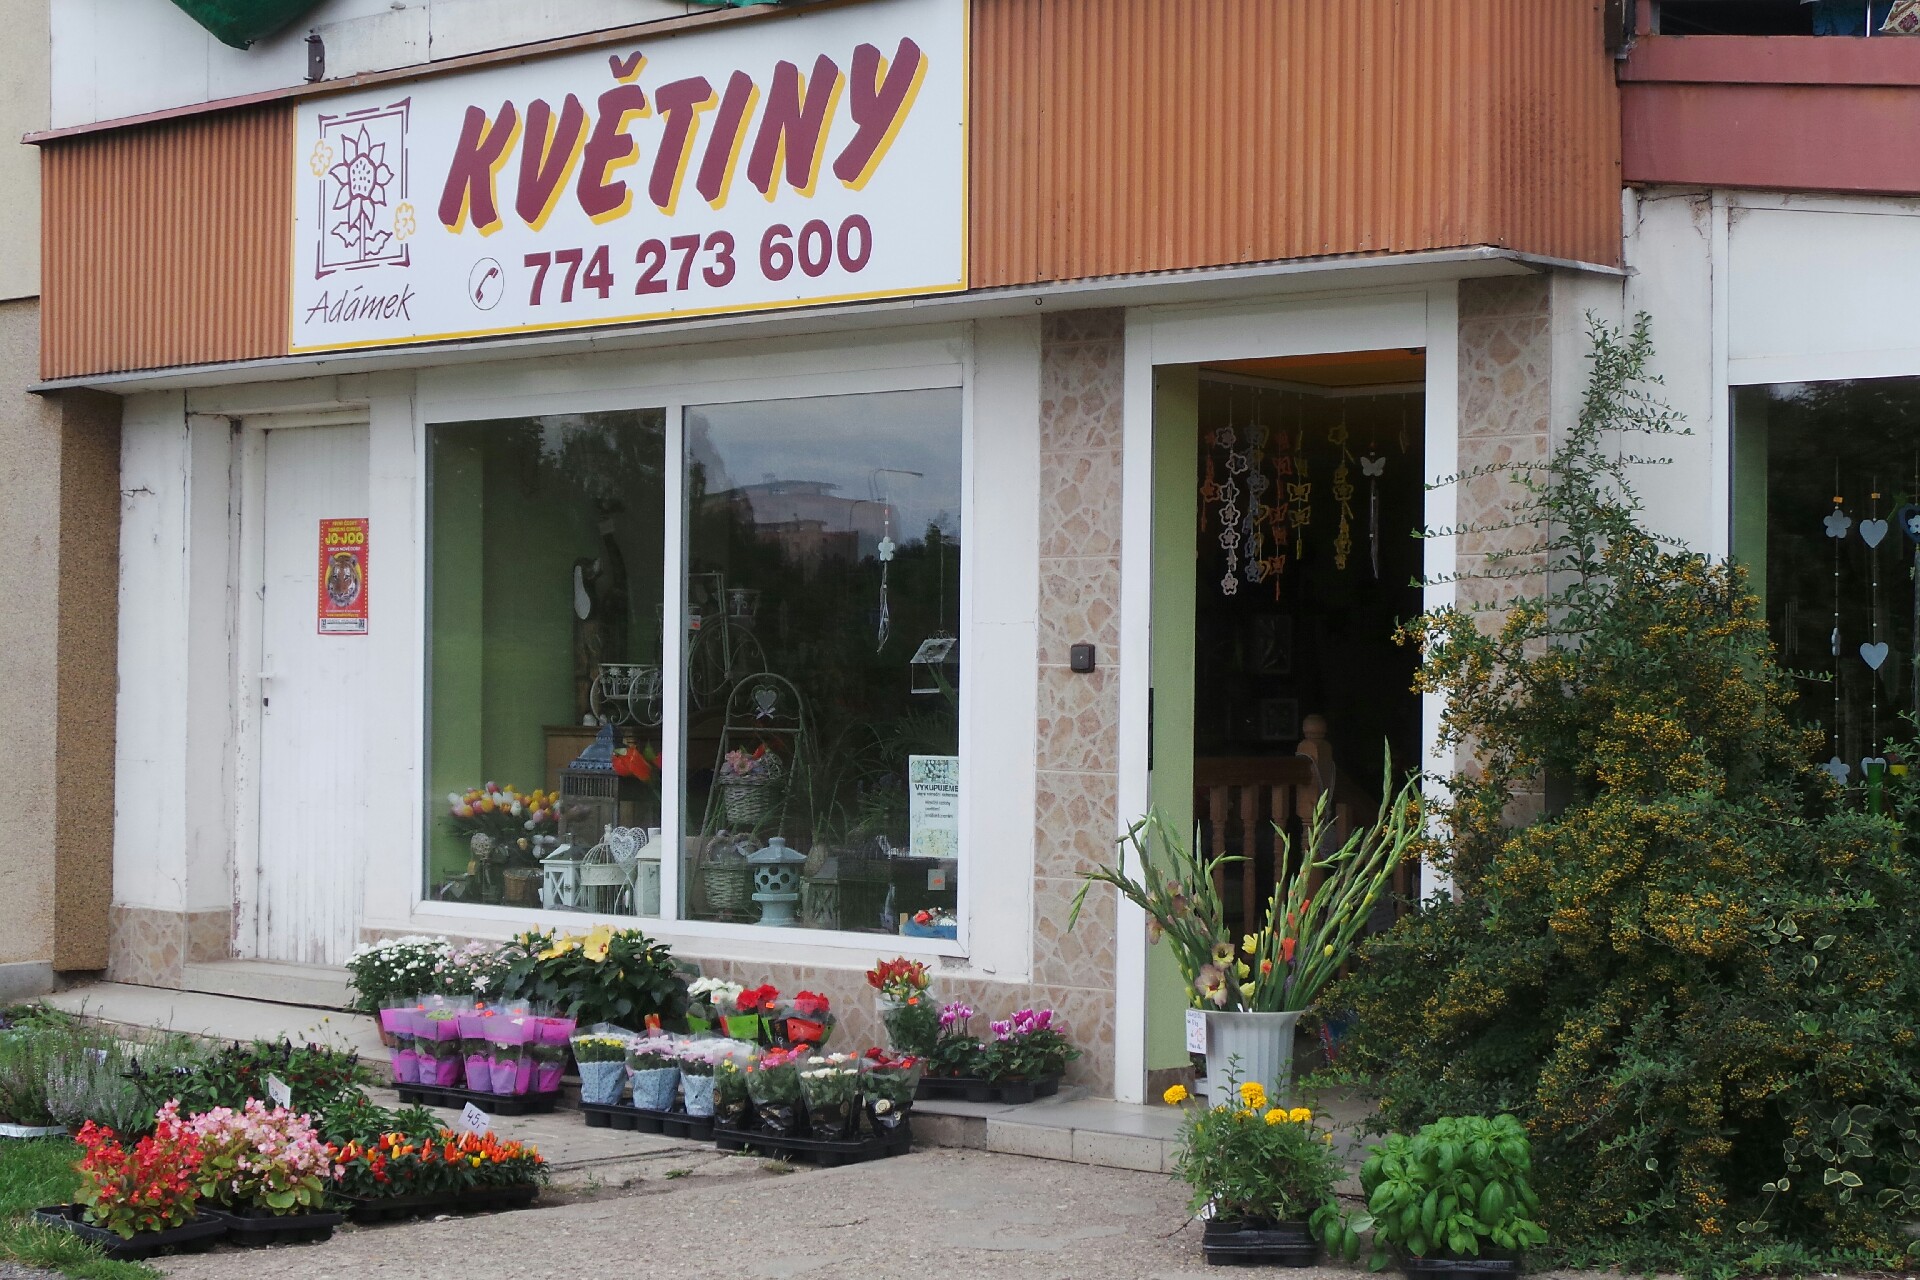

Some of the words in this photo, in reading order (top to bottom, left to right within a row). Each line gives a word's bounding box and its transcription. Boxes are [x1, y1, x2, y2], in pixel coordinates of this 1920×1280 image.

[438, 37, 927, 236] KVĚTINY
[523, 245, 614, 306] 774
[635, 230, 736, 296] 273
[760, 214, 872, 281] 600
[304, 283, 416, 324] Adámek
[914, 783, 959, 793] VYKUPUJEME
